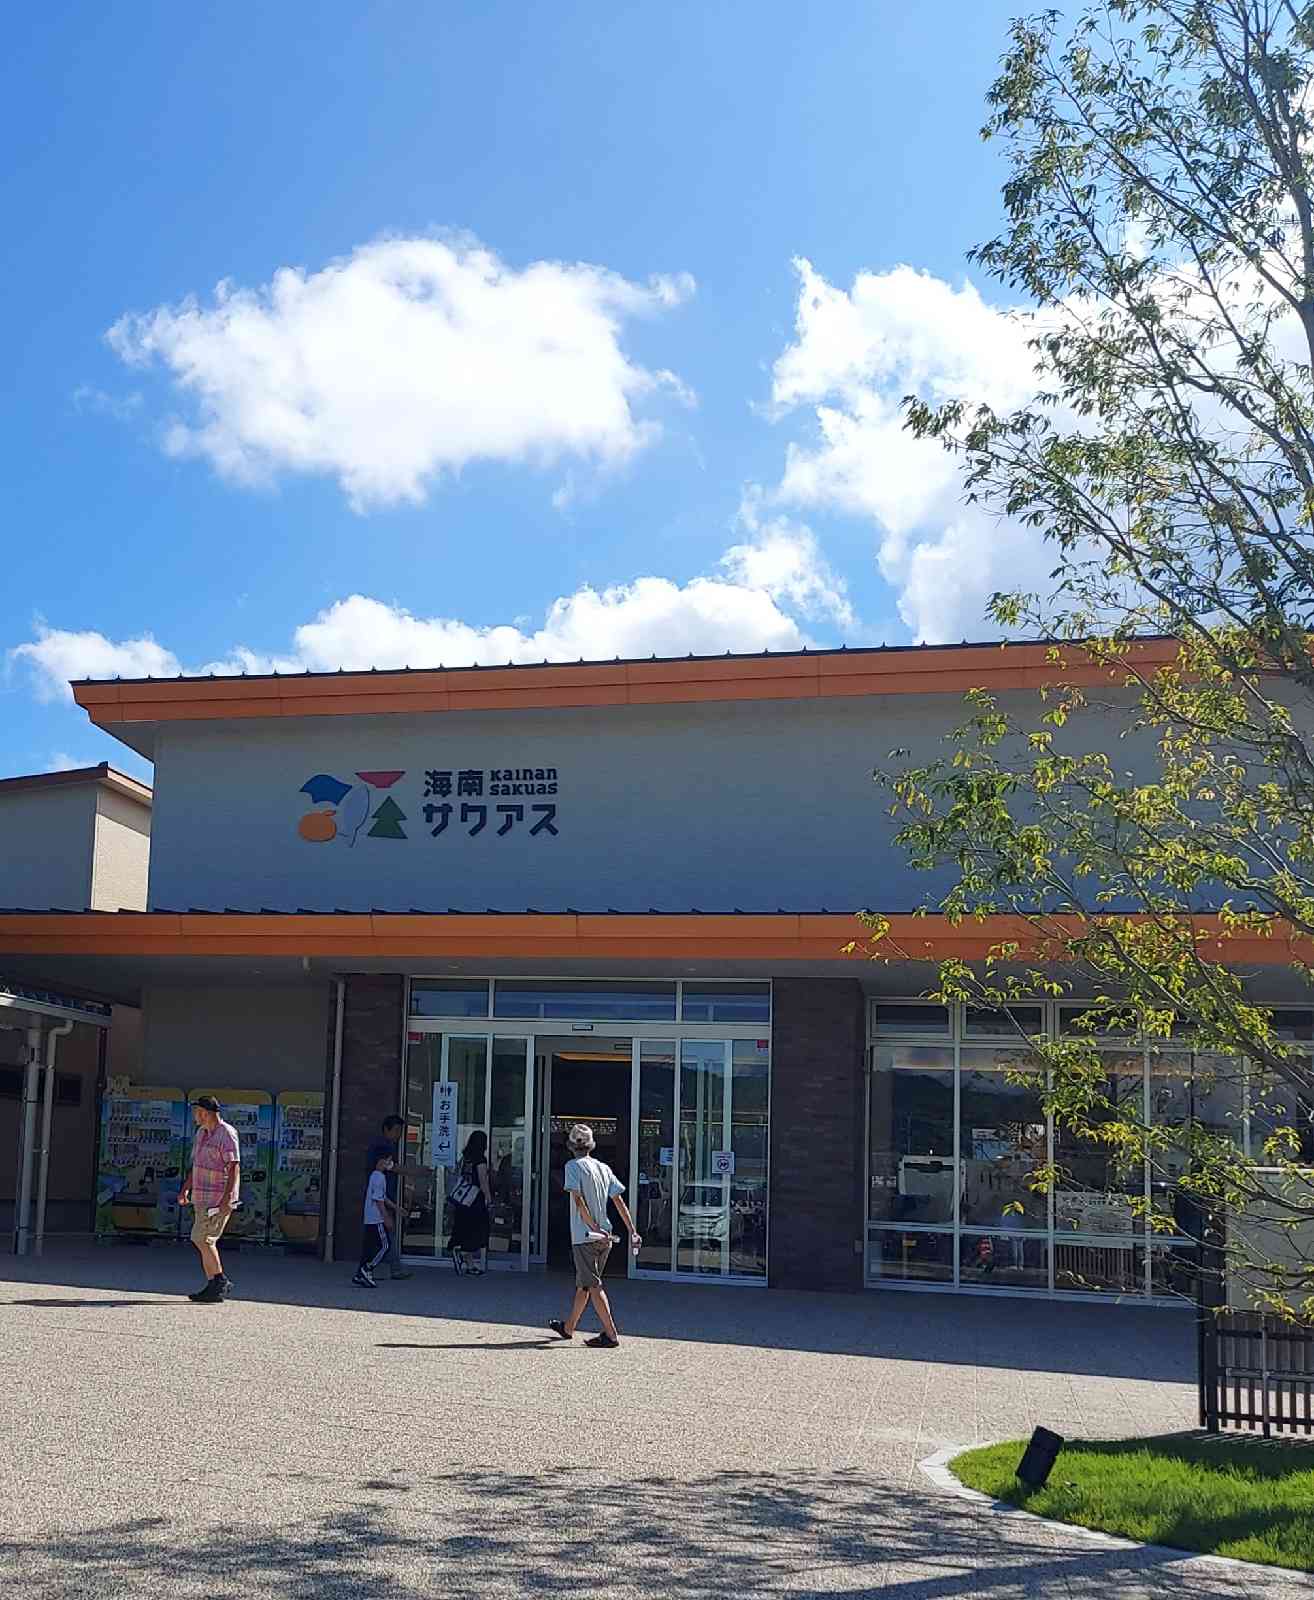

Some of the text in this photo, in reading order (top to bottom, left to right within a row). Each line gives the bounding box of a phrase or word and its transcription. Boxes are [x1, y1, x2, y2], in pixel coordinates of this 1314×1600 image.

[423, 769, 483, 797] 海南
[422, 802, 559, 837] サクアス
